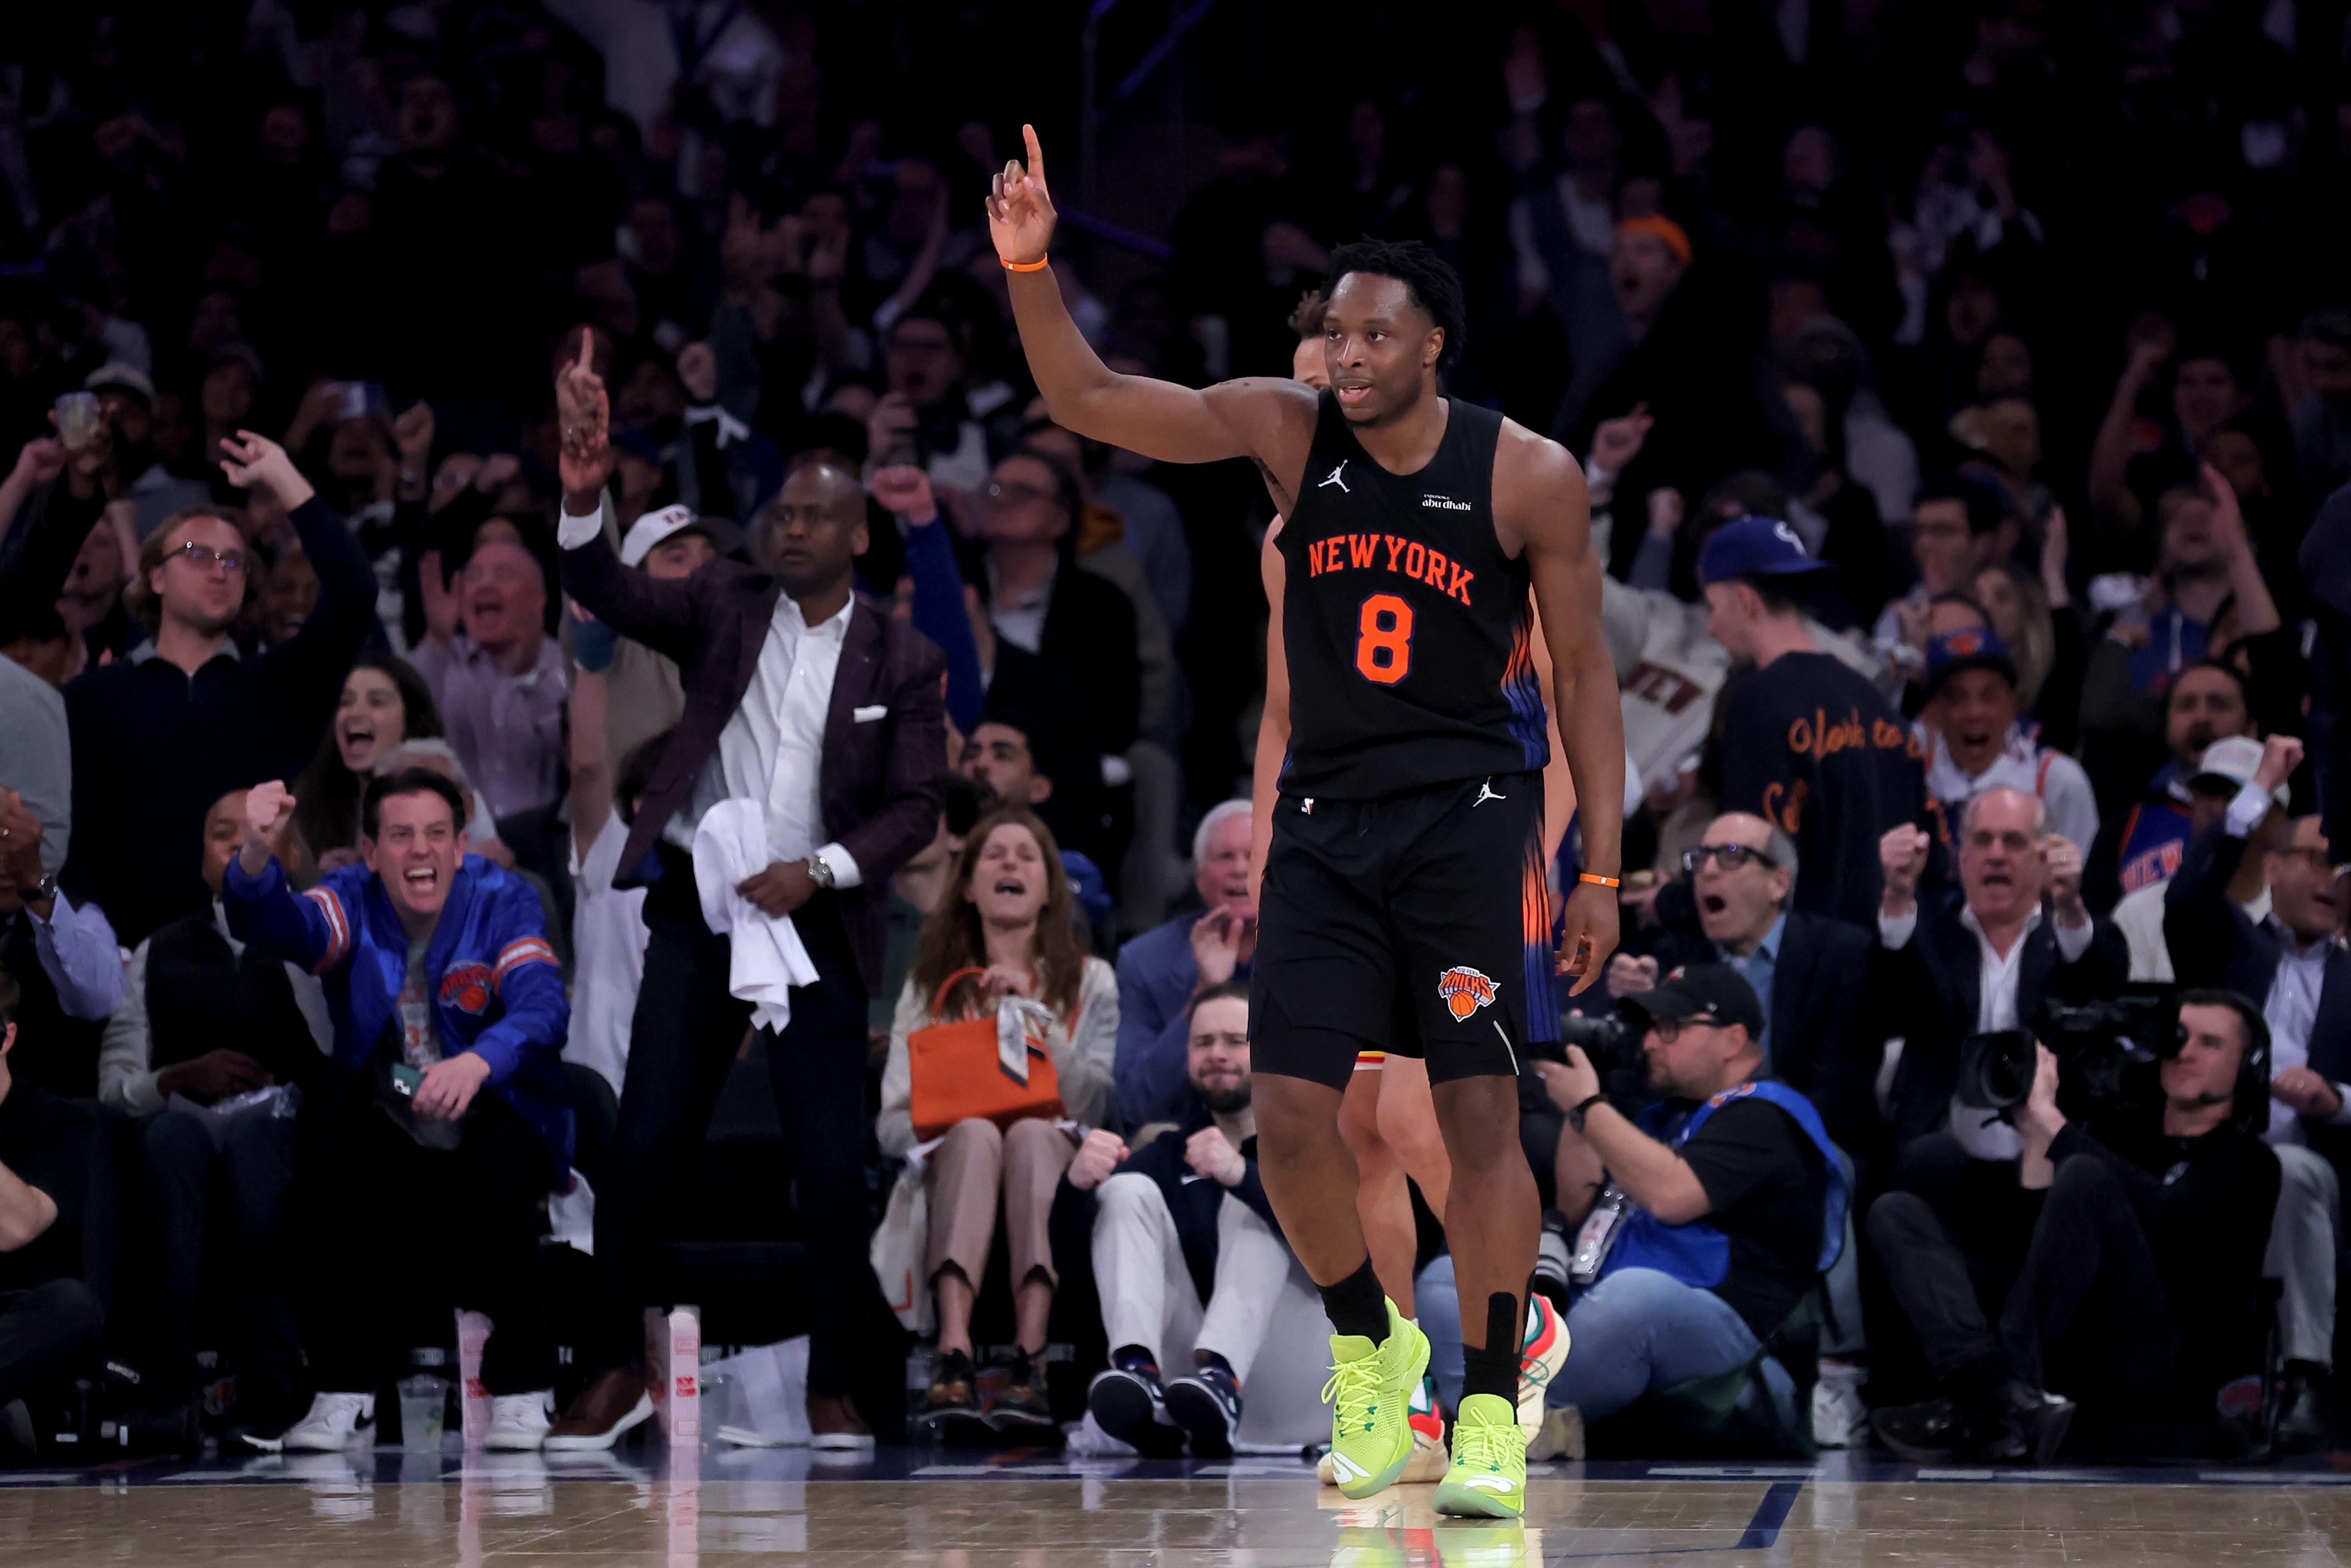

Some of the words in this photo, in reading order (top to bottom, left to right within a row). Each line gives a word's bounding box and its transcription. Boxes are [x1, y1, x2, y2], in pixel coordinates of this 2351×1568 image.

[1422, 499, 1442, 508] abu
[1442, 500, 1472, 511] dhabi
[1309, 534, 1381, 578] NEW
[1384, 534, 1475, 606] YORK
[1354, 591, 1417, 688] 8
[1440, 970, 1493, 1000] KNICKS
